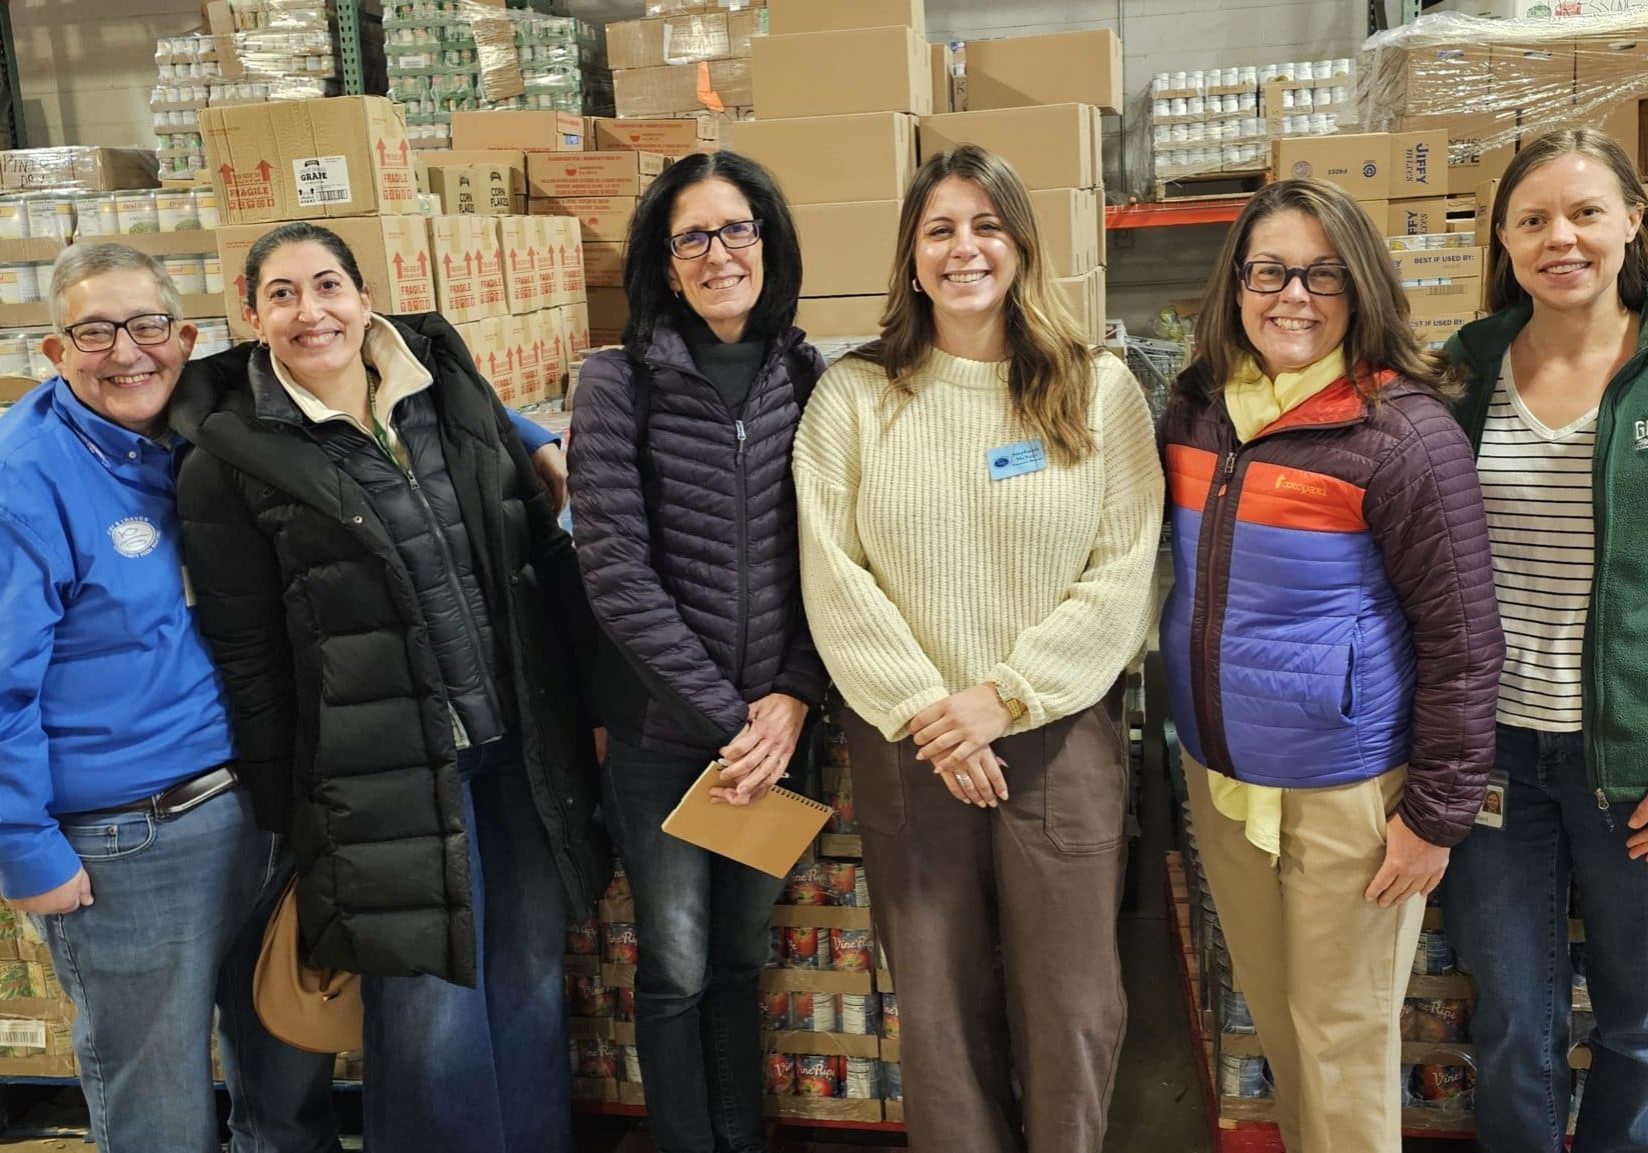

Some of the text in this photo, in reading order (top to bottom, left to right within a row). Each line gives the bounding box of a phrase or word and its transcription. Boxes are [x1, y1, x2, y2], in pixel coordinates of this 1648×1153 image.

[1415, 143, 1429, 184] JIFFY
[383, 173, 409, 183] FRAGILE
[228, 186, 270, 198] FRAGILE
[1407, 211, 1419, 235] FFY
[1442, 255, 1461, 263] USED
[400, 283, 428, 296] FRAGILE
